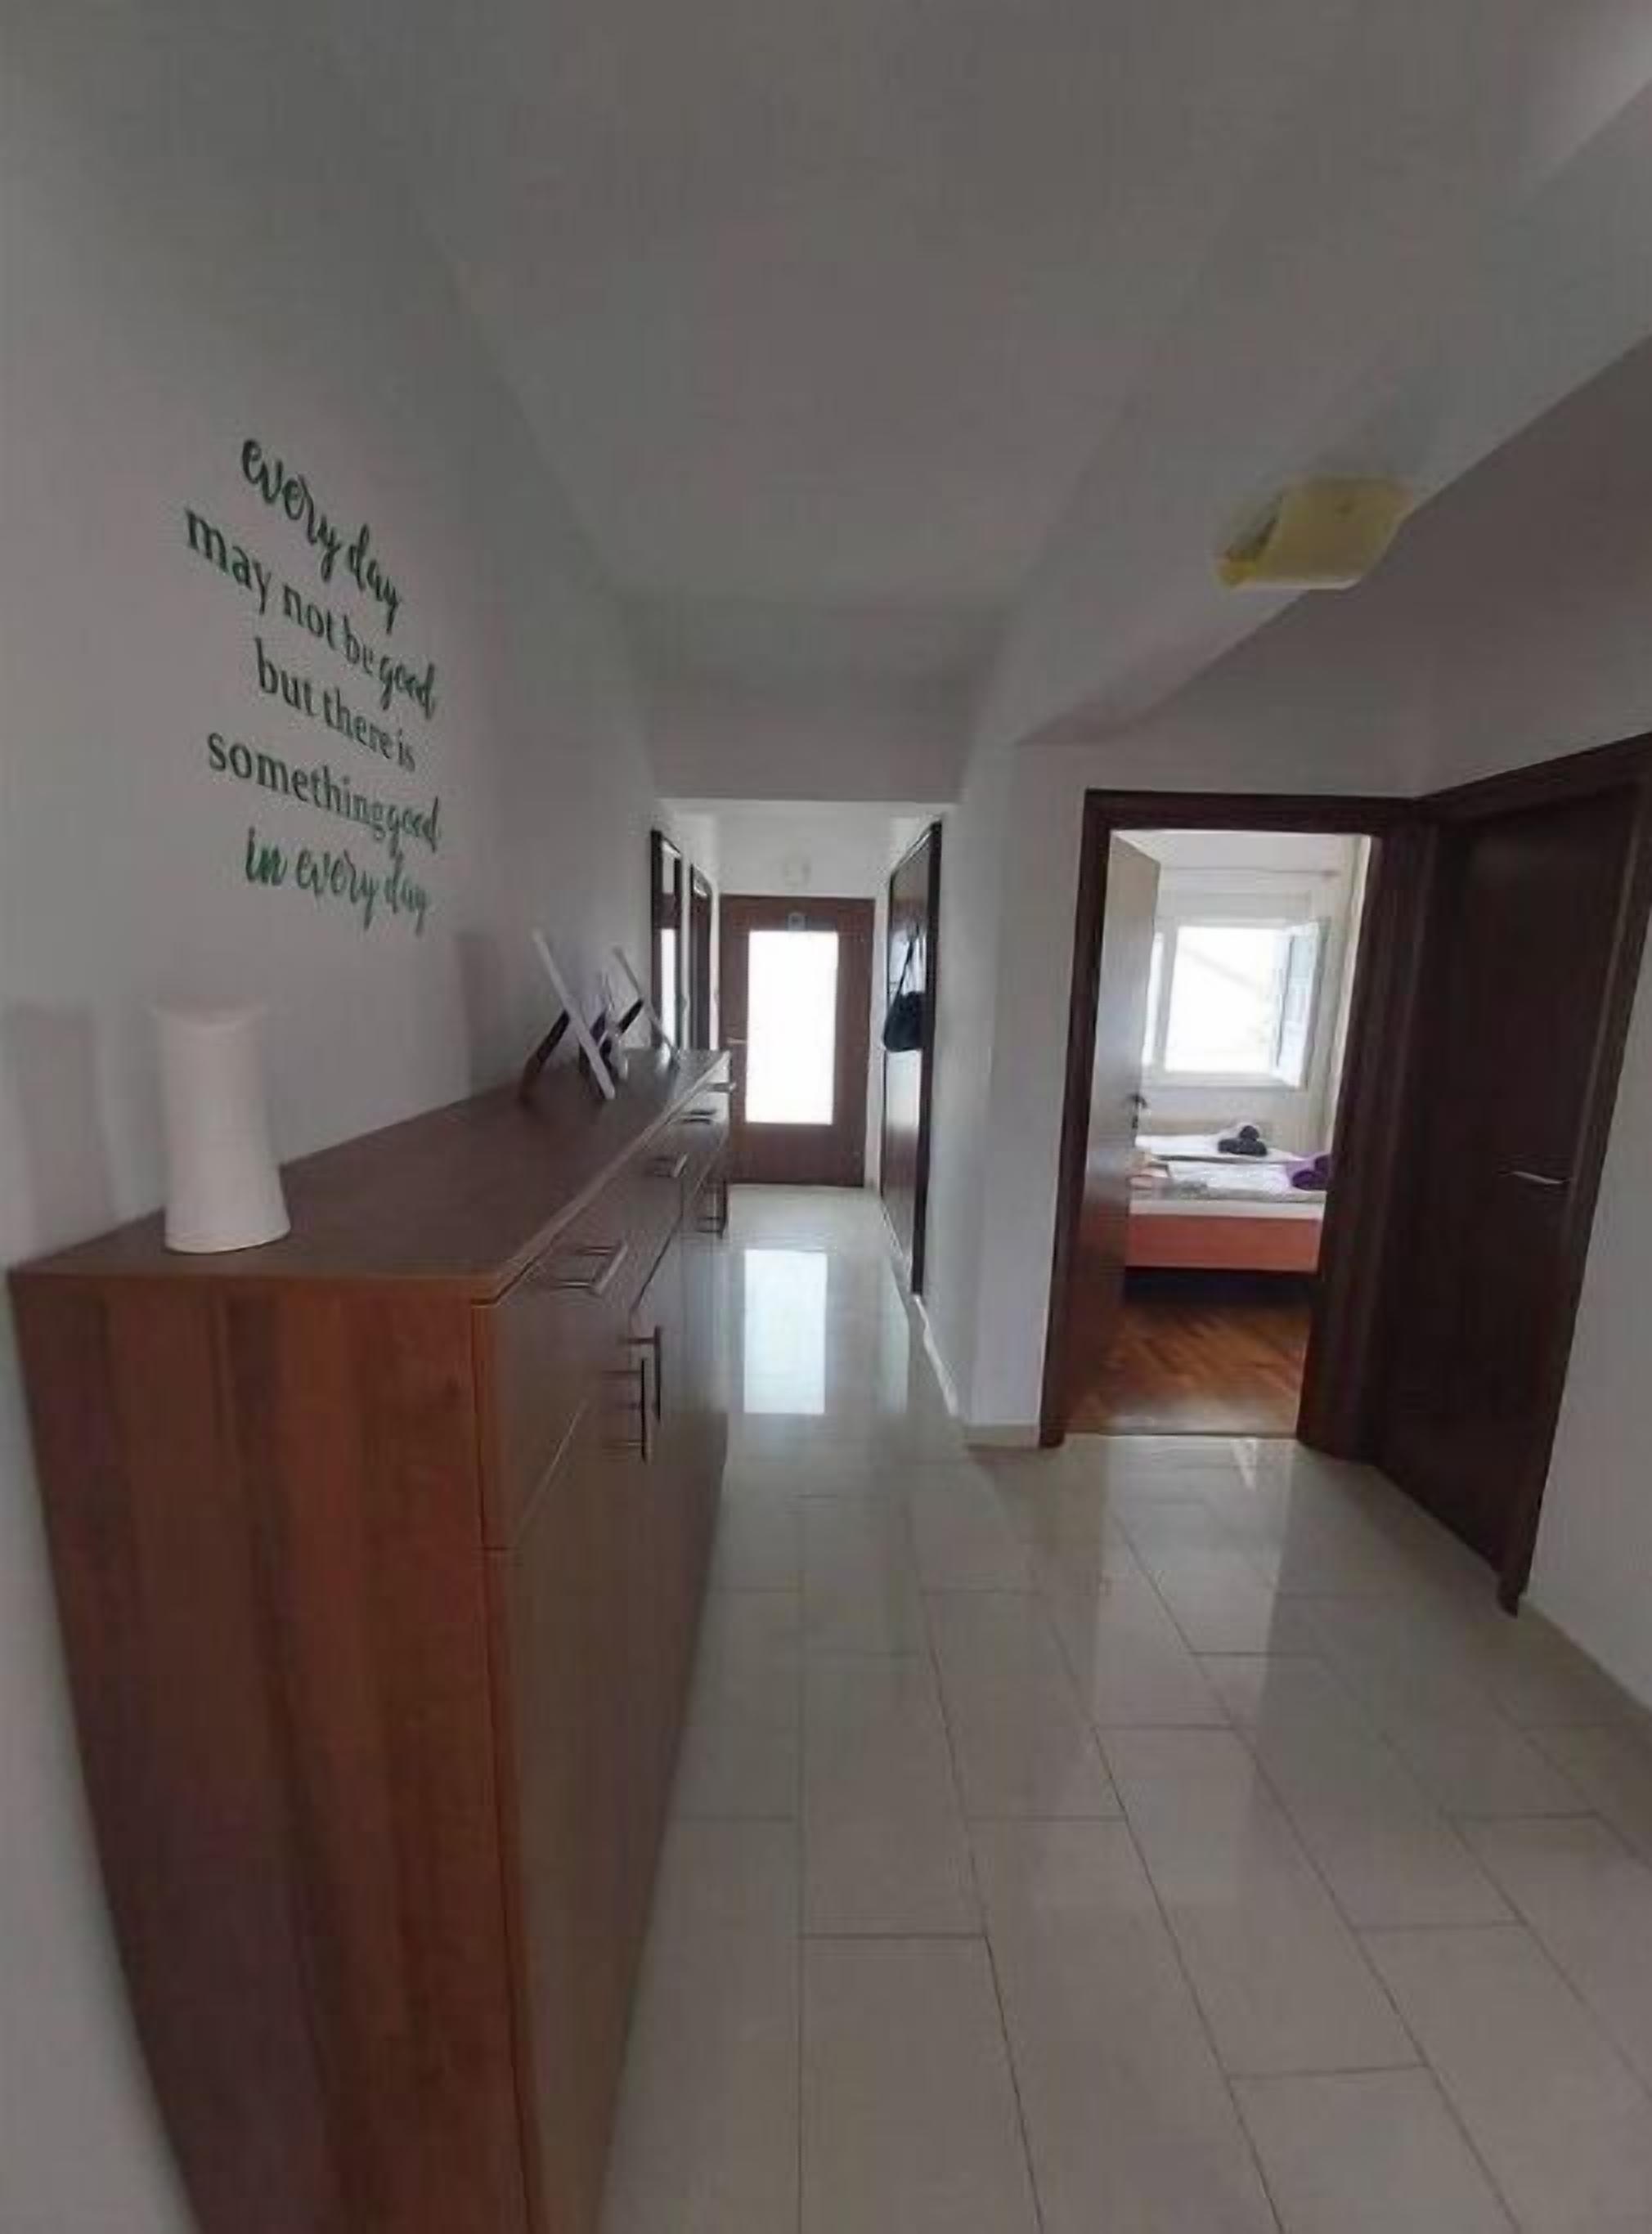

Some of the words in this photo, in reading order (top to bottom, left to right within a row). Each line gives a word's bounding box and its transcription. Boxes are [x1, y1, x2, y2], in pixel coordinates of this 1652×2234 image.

[241, 439, 341, 583] every
[347, 524, 402, 635] day
[186, 506, 271, 614] may
[283, 583, 337, 650] not
[379, 654, 436, 720] good
[255, 636, 316, 717] but
[324, 688, 392, 760] there
[398, 729, 415, 772] is
[207, 732, 386, 841] something
[386, 796, 440, 859] good
[245, 826, 287, 886] in
[296, 848, 379, 931] every
[383, 850, 429, 936] day
